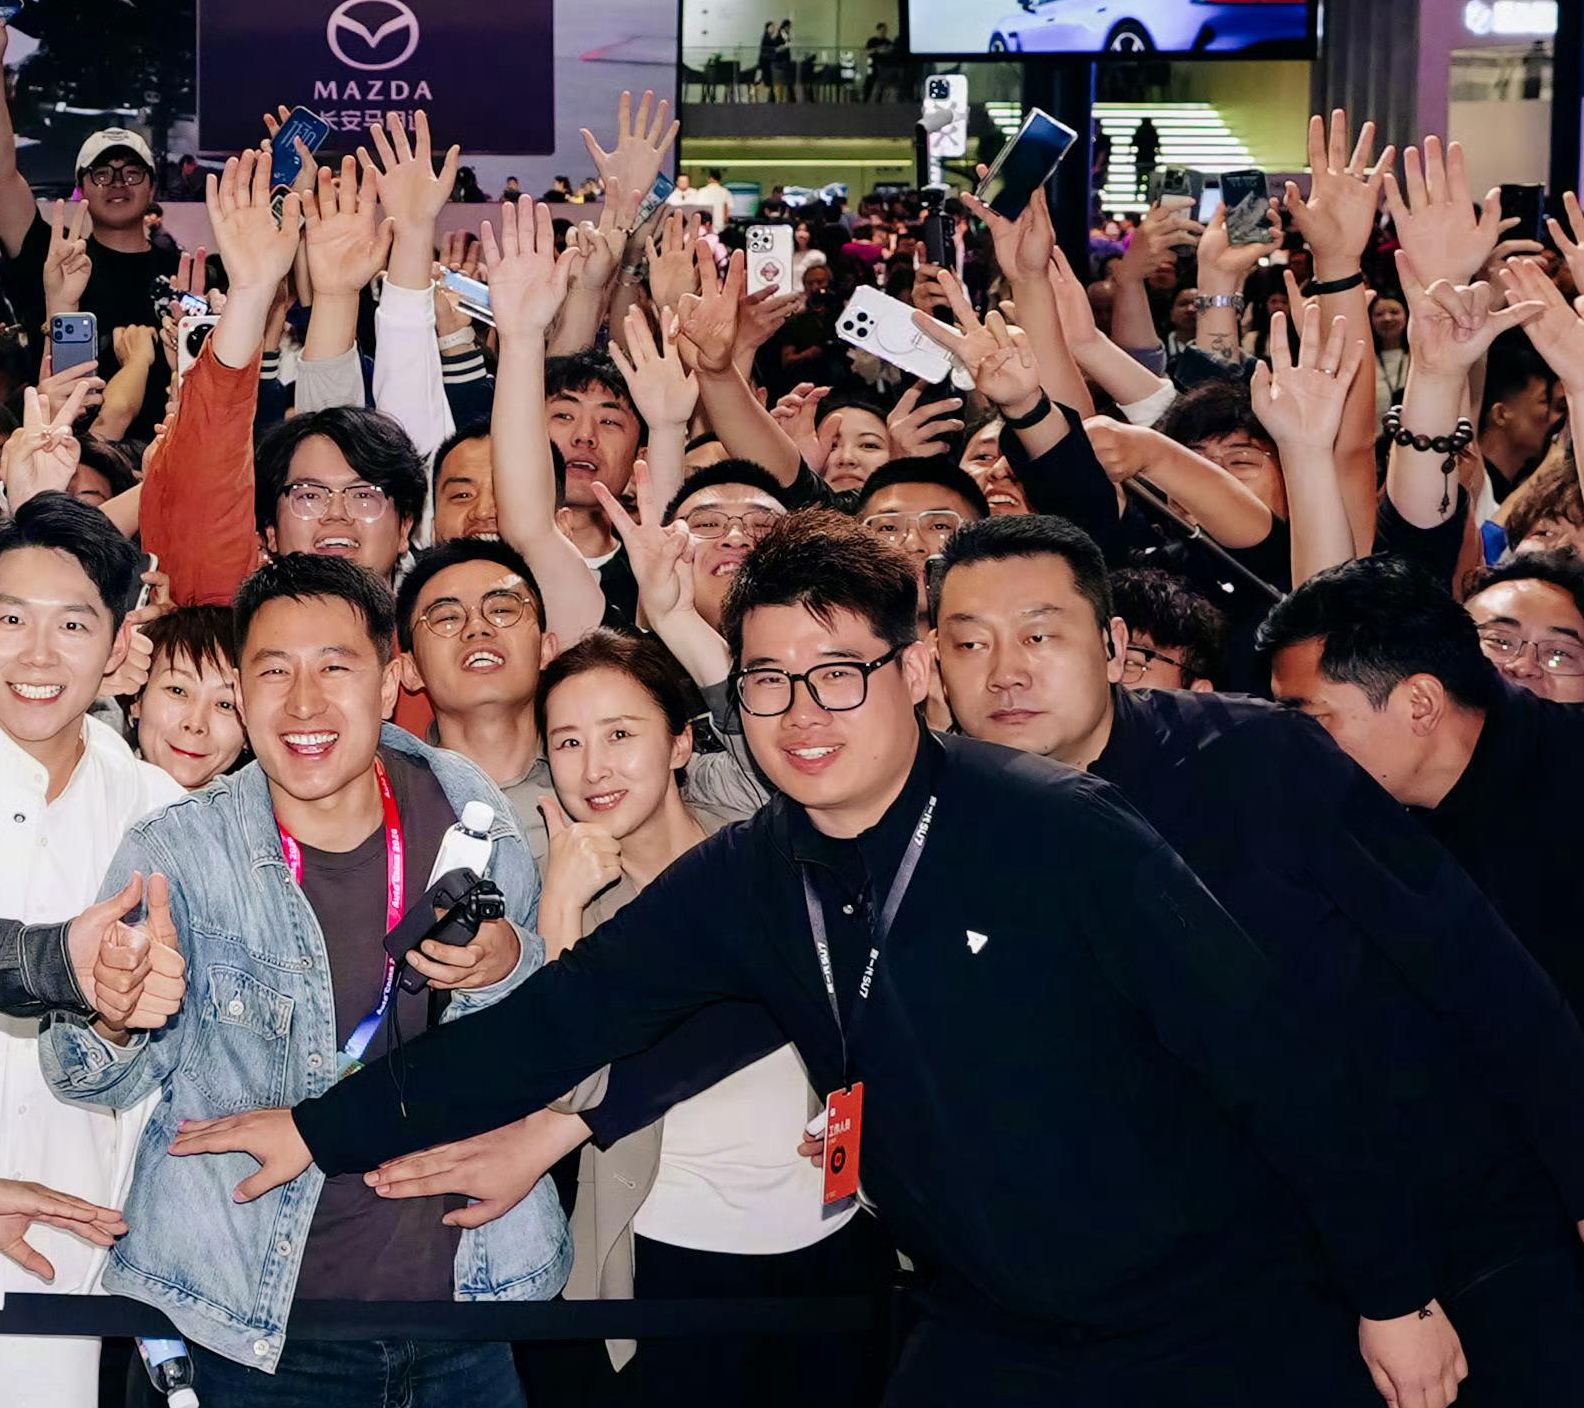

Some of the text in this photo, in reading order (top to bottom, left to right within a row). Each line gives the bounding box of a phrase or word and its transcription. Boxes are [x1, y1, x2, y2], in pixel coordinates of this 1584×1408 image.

[313, 80, 433, 100] MAZDA
[319, 109, 419, 132] 长安马
